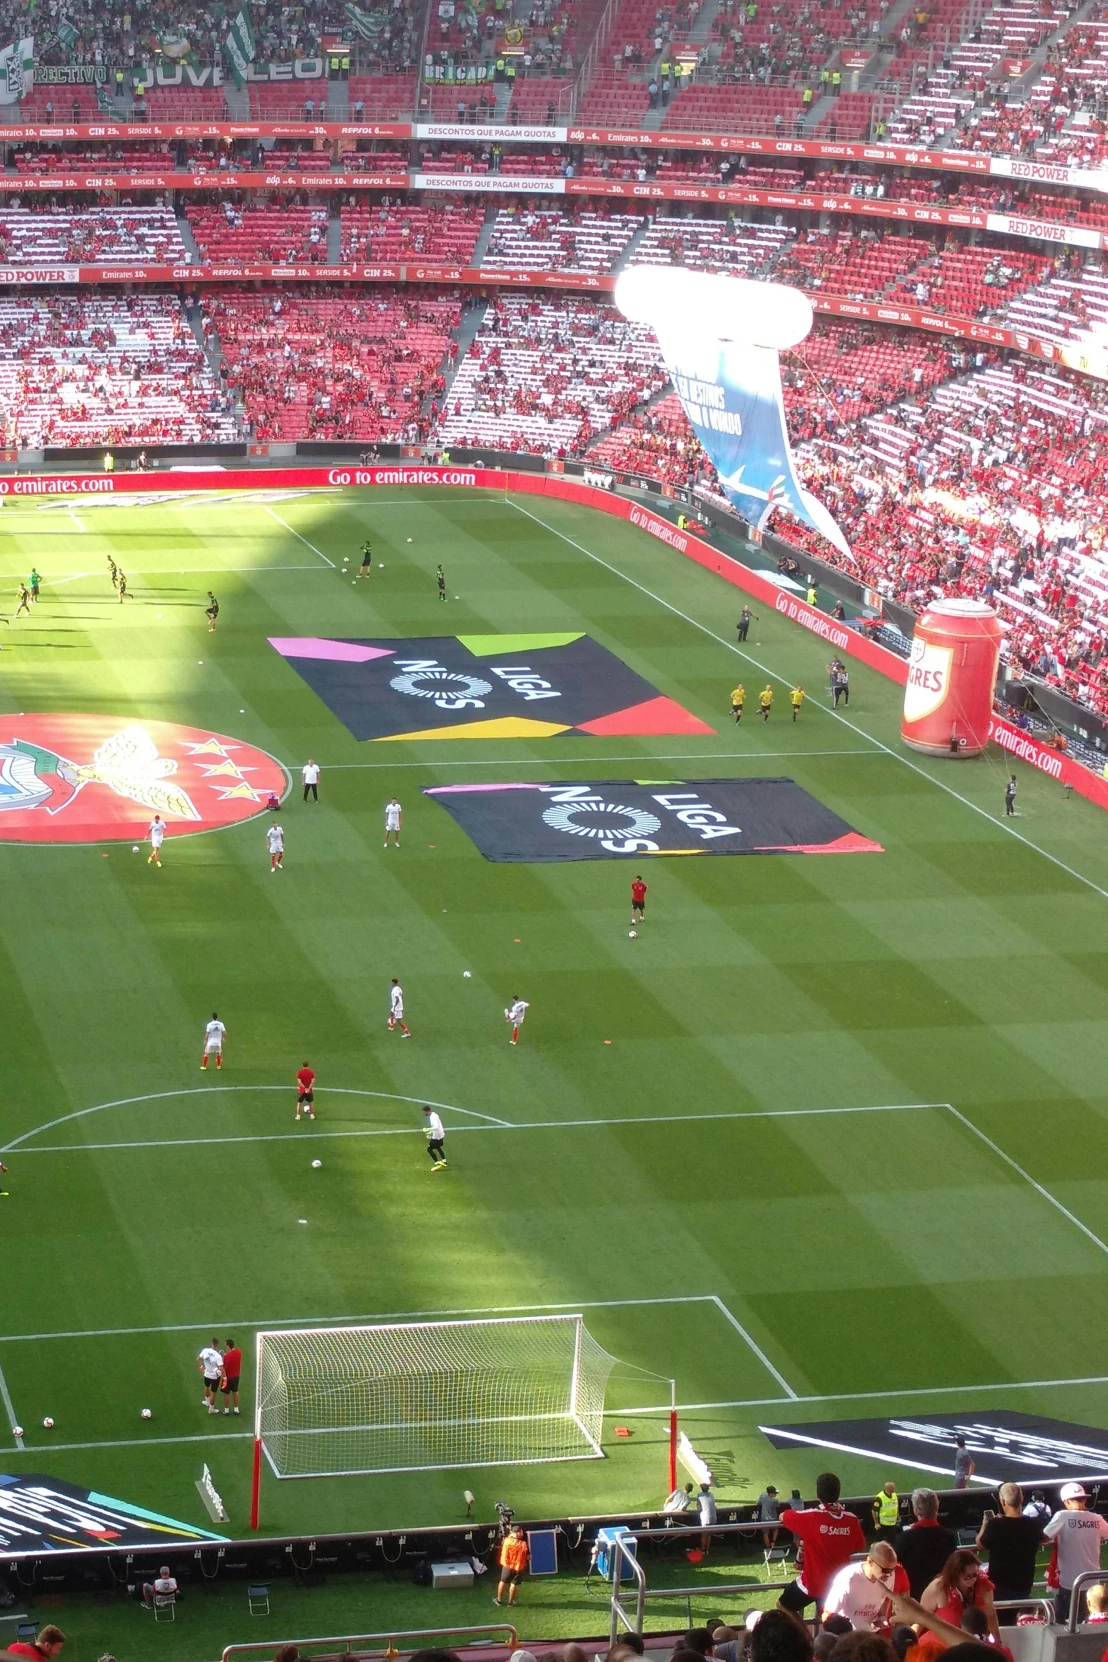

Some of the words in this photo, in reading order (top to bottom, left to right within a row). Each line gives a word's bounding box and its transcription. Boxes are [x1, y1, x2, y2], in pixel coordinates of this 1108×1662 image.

[34, 66, 107, 83] RECTIVO
[132, 65, 224, 88] JUVE
[428, 127, 475, 136] DESCONTOS
[476, 128, 493, 136] QUE
[494, 129, 522, 137] PAGAM
[524, 129, 556, 138] QUOTAS
[608, 133, 638, 142] Emirates
[776, 142, 792, 151] CIN
[1010, 161, 1031, 178] RED
[1032, 163, 1070, 182] POWER
[86, 178, 102, 187] CIN
[426, 179, 473, 187] DESCONTOS
[475, 180, 491, 188] QUE
[493, 180, 520, 188] PAGAM
[522, 181, 554, 190] QUOTAS
[634, 186, 649, 195] CIN
[915, 210, 930, 220] CIN
[1009, 220, 1027, 234] RED
[1028, 223, 1066, 241] POWER
[16, 270, 65, 281] POWER
[103, 270, 133, 278] Emirates
[173, 269, 189, 277] CIN
[364, 269, 380, 277] CIN
[328, 469, 352, 485] Go
[356, 470, 371, 484] to
[376, 468, 476, 486] emirates.com
[14, 477, 114, 493] emirates.com
[630, 506, 640, 523] Go
[640, 513, 648, 528] to
[647, 517, 688, 553] emirates.com
[776, 592, 788, 611] Go
[788, 601, 798, 618] to
[797, 609, 848, 649] emirates.com
[489, 666, 562, 701] LIGA
[910, 666, 942, 692] GRES
[994, 725, 1063, 778] emirates.com
[651, 793, 743, 839] LIGA
[1078, 1519, 1100, 1529] SAGRES
[828, 1526, 850, 1536] SAGRES
